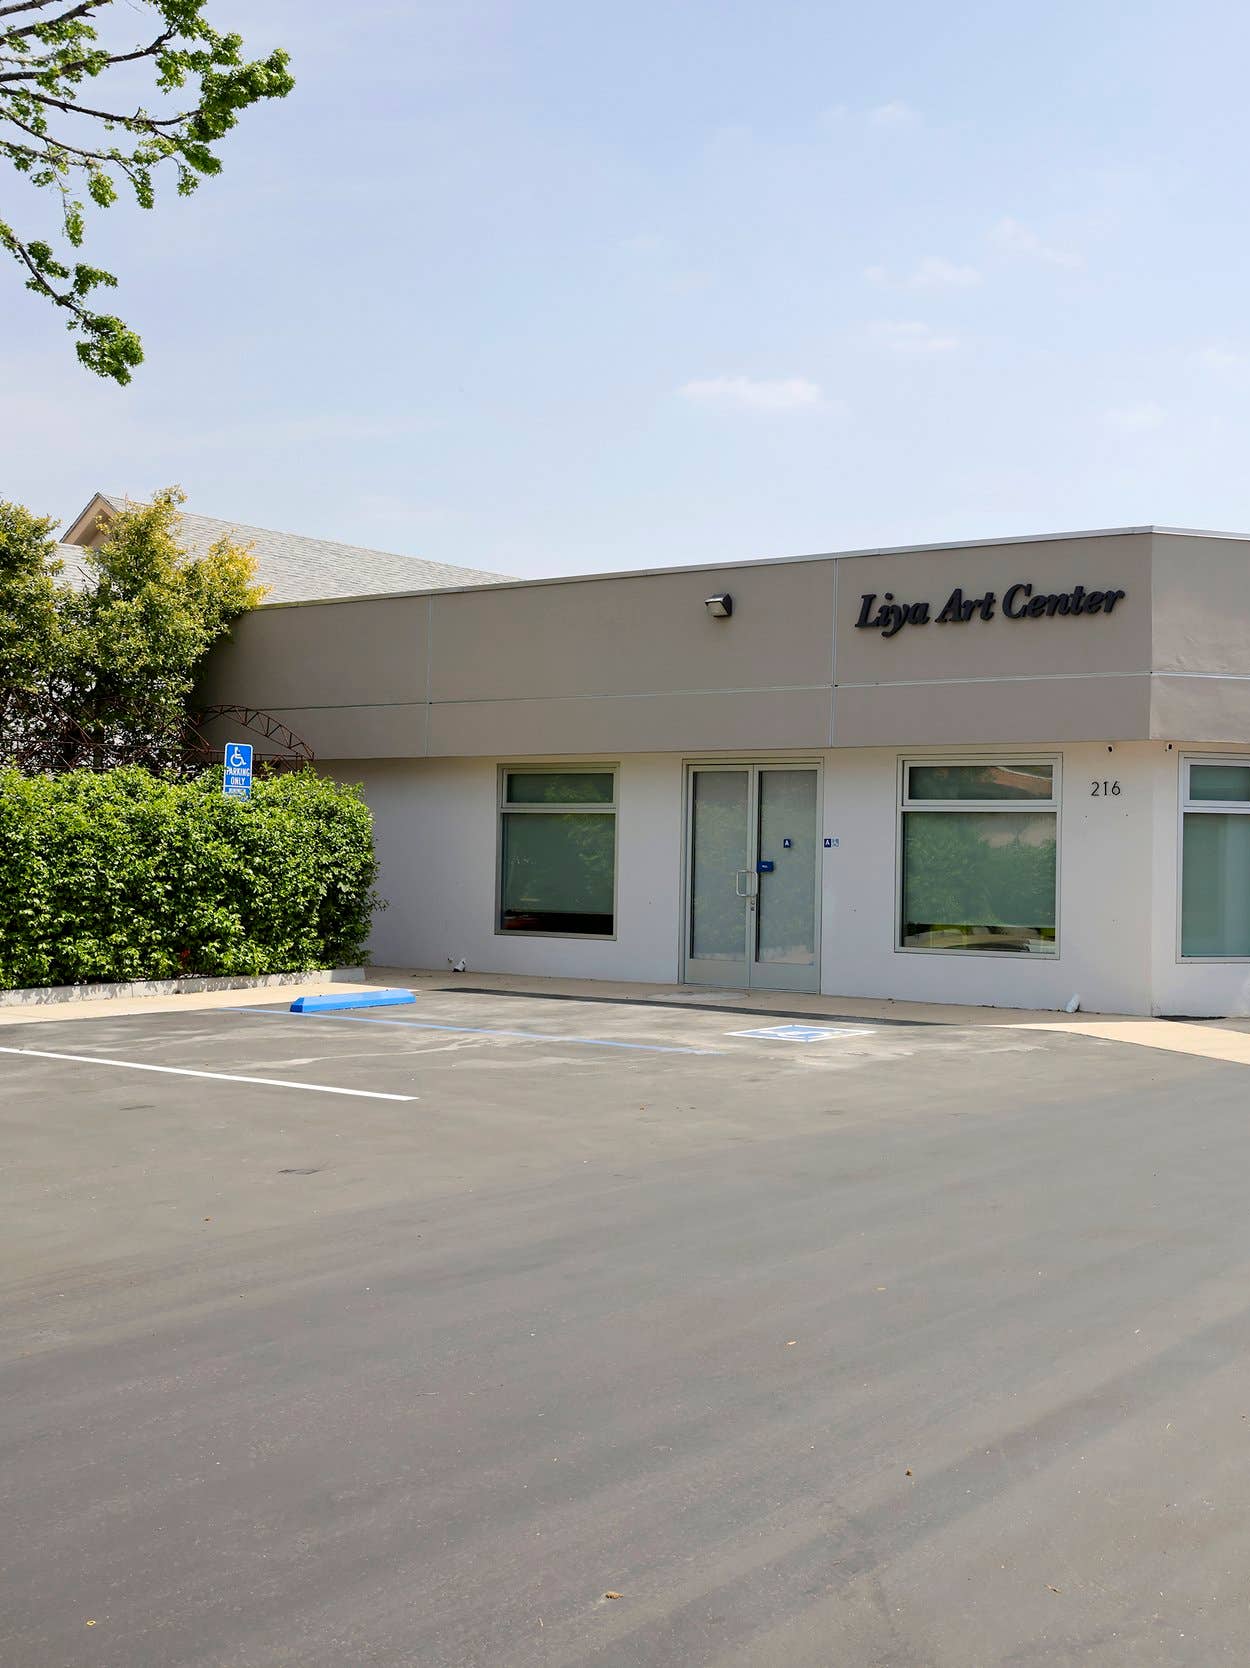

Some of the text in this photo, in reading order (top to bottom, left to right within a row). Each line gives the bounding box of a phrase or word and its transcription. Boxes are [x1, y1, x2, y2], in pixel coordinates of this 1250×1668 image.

[855, 583, 1126, 638] Liya Art Center
[226, 767, 251, 776] PARKING
[230, 777, 246, 785] ONLY
[1091, 781, 1120, 796] 216
